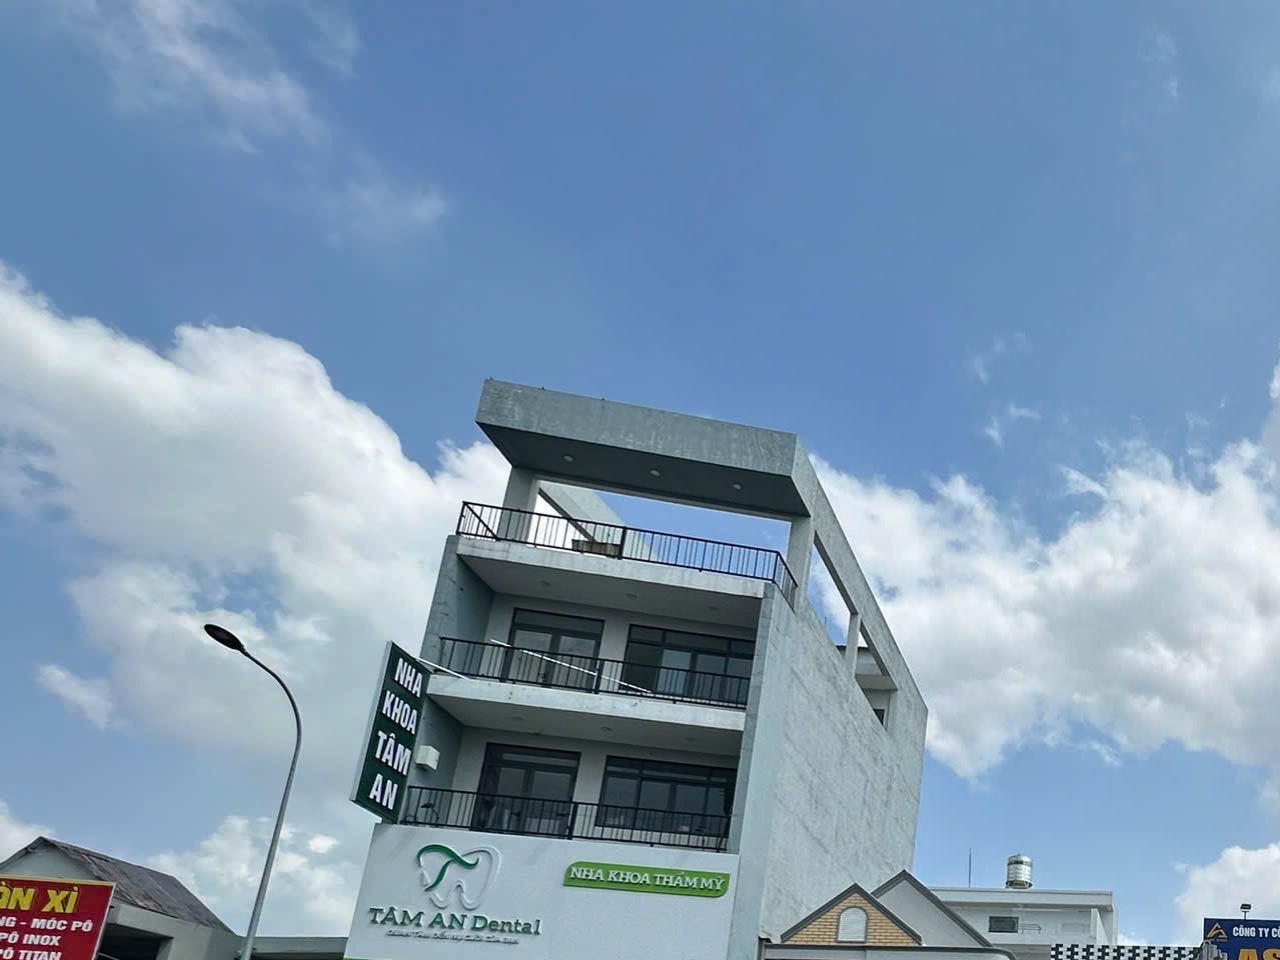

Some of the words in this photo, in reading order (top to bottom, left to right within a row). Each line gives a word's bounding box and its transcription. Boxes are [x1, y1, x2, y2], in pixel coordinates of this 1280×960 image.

[394, 657, 423, 698] NHA
[382, 690, 418, 735] KHOA
[374, 730, 412, 776] TÂM
[369, 773, 399, 811] AN
[570, 867, 604, 881] NHA
[607, 869, 650, 885] KHOA
[369, 906, 425, 928] TÂM
[428, 912, 468, 931] AN
[471, 914, 541, 936] Dental
[1232, 925, 1256, 937] CÔNG
[1258, 927, 1270, 937] TY
[22, 934, 61, 946] INOX
